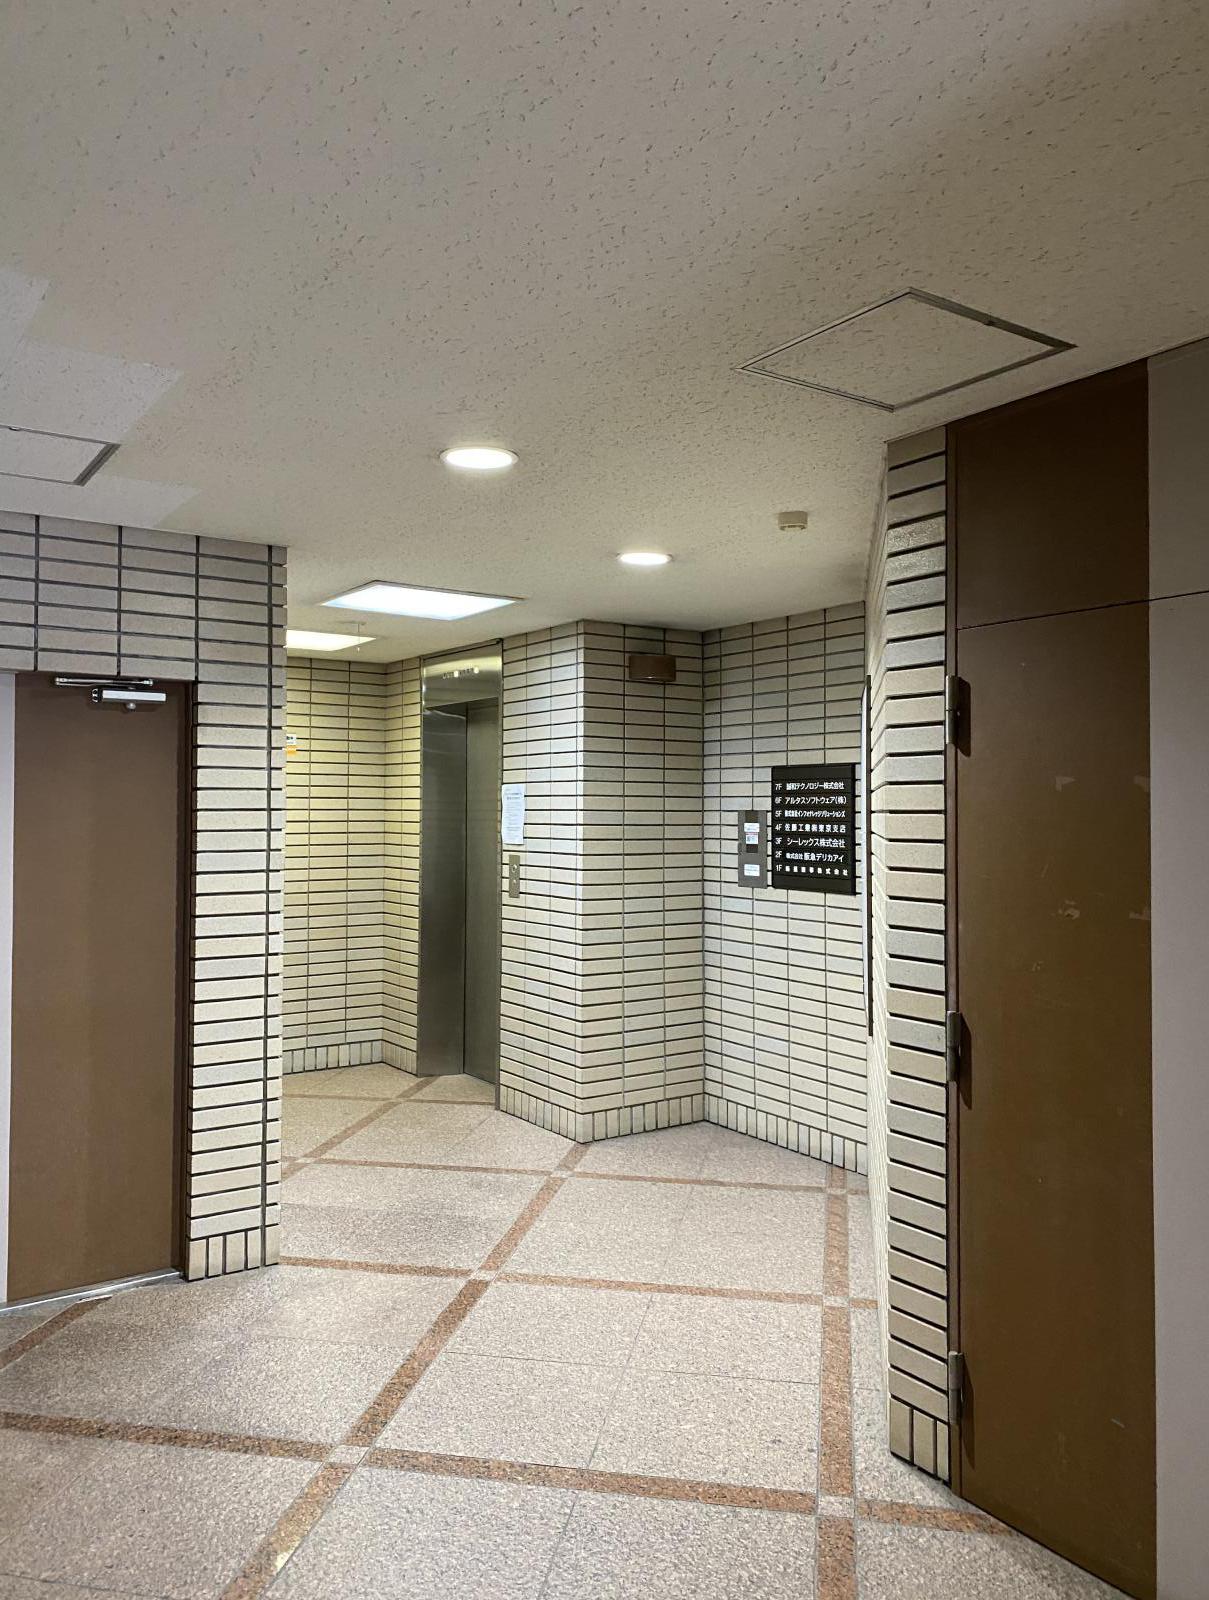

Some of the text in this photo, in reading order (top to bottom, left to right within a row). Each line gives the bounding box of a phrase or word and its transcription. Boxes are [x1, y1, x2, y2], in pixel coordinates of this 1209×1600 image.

[775, 810, 783, 818] 5F
[775, 823, 783, 831] 4F
[775, 837, 846, 848] 3F シーレックス株式会社
[775, 850, 783, 858] 2F
[776, 864, 783, 872] 1F
